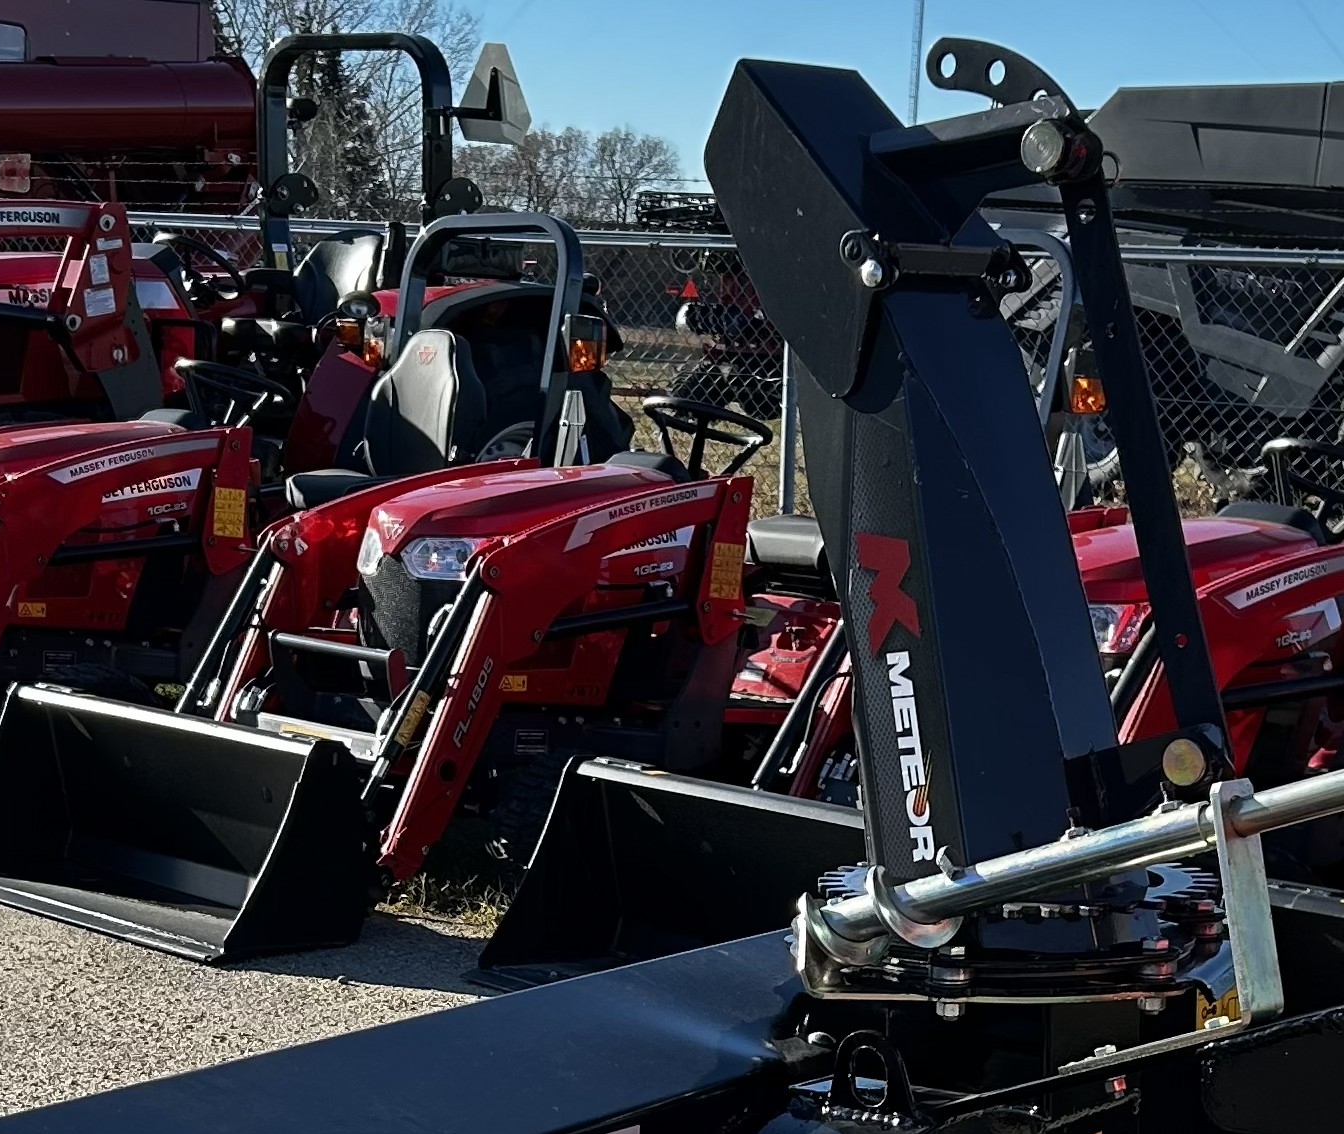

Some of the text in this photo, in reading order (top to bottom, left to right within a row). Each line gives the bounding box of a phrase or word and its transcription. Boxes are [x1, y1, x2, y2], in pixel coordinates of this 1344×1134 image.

[0, 211, 60, 224] FERGUSON
[69, 448, 155, 478] MASSEY FERGUSON
[609, 489, 698, 520] MASSEY FERGUSON
[1246, 562, 1329, 601] MASSEY FERGUSON
[453, 656, 494, 749] FL 1805
[886, 651, 935, 864] METEOR
